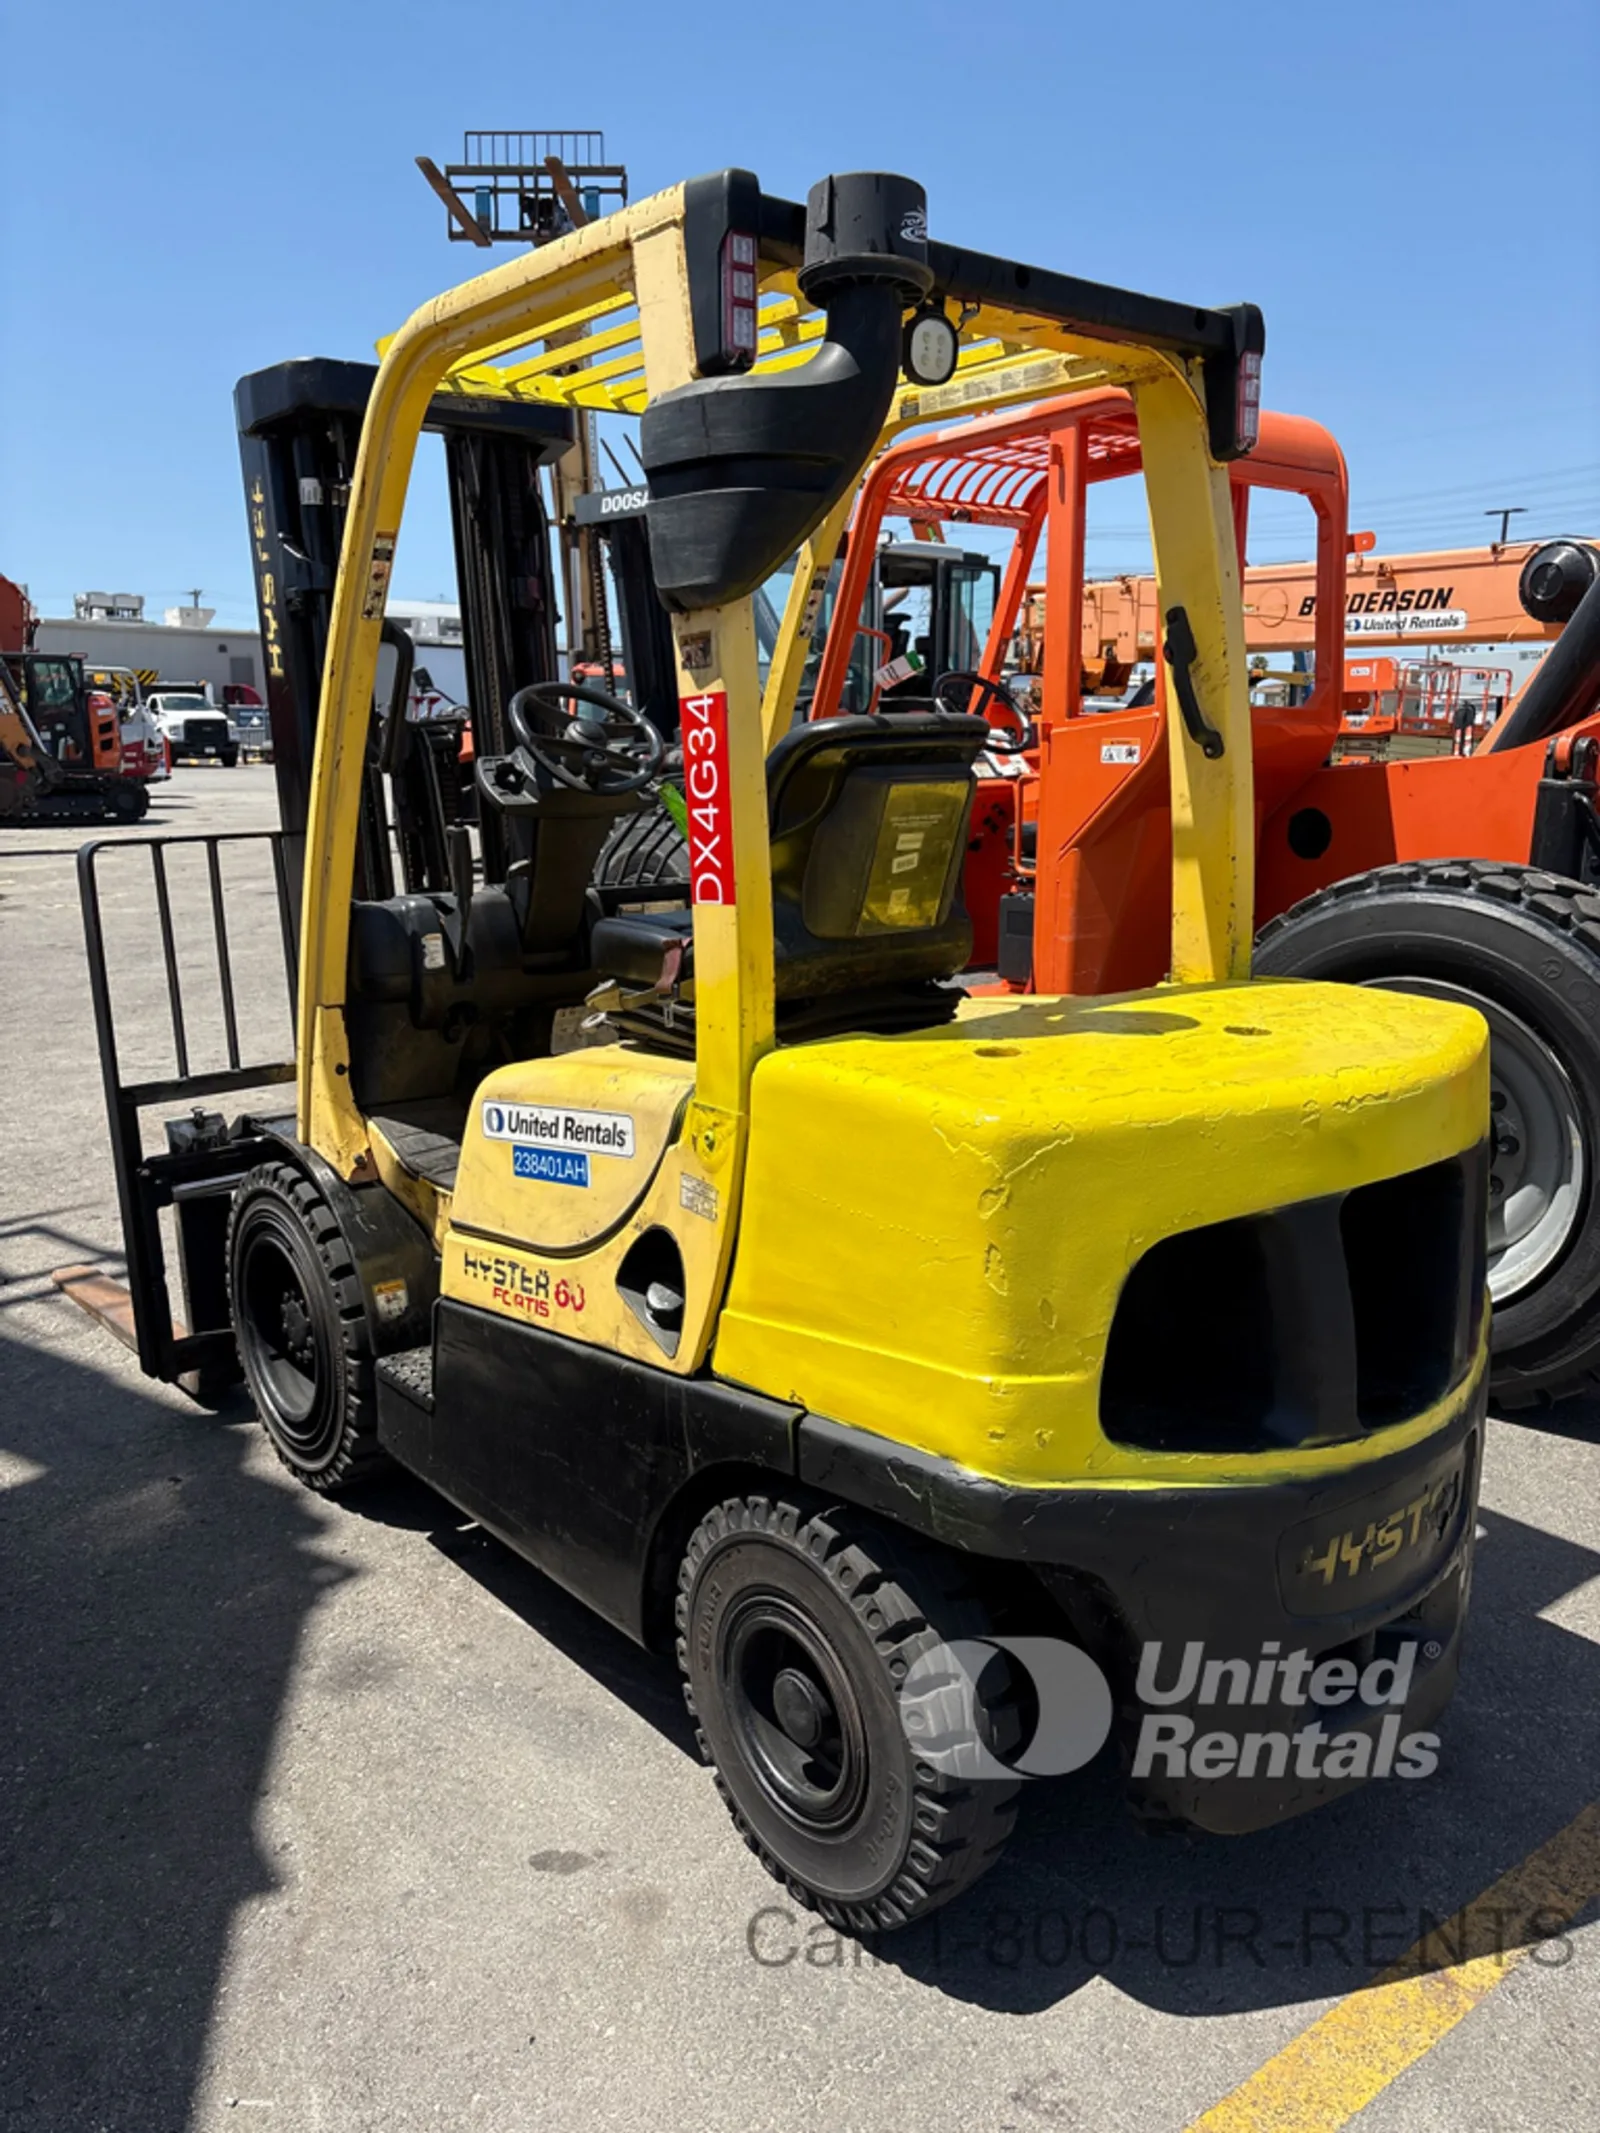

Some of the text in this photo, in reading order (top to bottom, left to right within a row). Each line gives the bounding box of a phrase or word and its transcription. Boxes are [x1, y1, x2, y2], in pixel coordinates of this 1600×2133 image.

[601, 489, 649, 514] DOOSA
[1299, 587, 1454, 617] BDERSON
[1362, 614, 1459, 631] United Rentals
[685, 694, 723, 905] DX4G34
[507, 1110, 626, 1147] United Rentals
[514, 1151, 587, 1181] 238401AH
[463, 1248, 550, 1298] HYSTER
[1306, 1477, 1445, 1587] HYST
